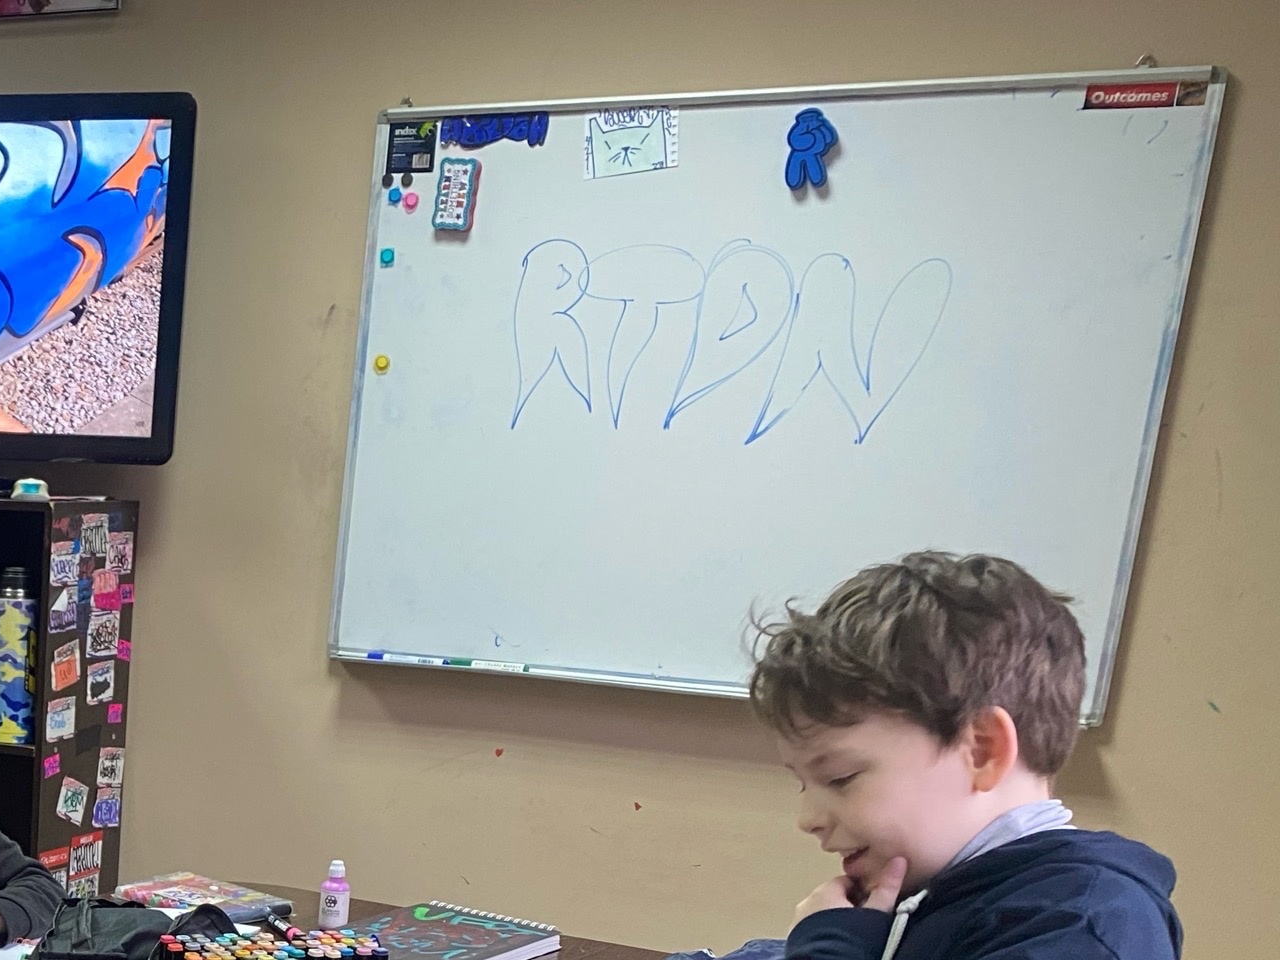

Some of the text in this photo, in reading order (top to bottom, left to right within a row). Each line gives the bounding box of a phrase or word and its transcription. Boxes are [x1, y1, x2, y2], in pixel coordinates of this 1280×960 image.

[1091, 90, 1170, 104] Outcomes
[394, 126, 418, 135] index
[446, 169, 461, 219] SOMETHING
